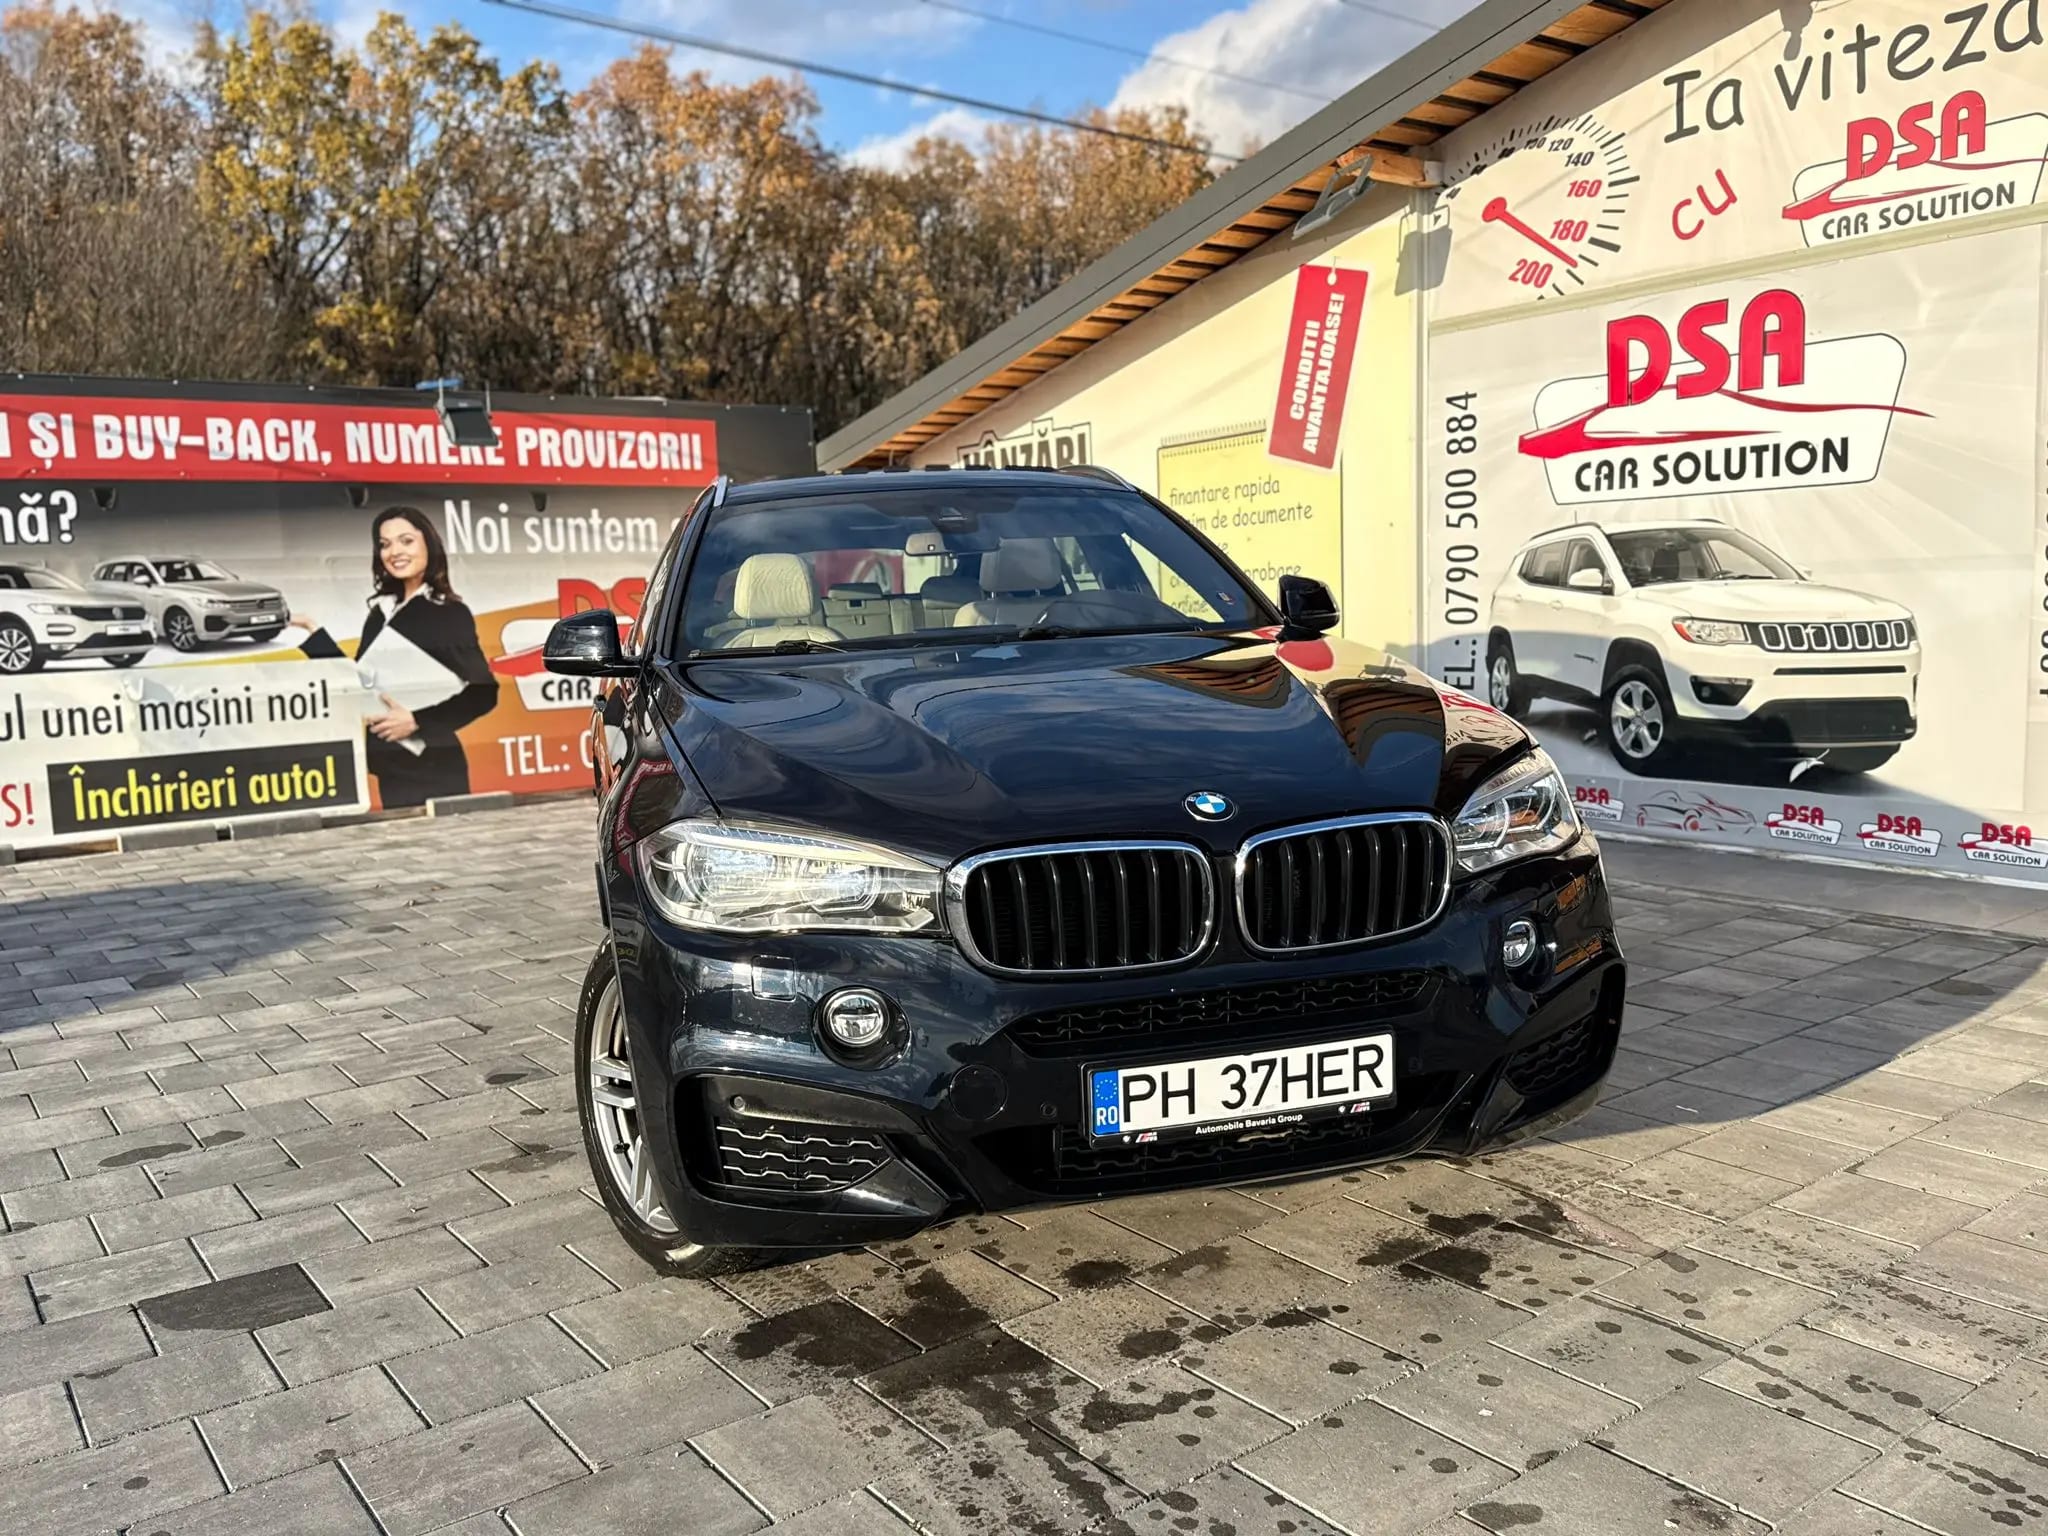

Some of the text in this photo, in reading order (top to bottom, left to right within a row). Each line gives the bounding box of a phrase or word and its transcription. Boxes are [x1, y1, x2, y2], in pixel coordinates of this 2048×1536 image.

[1774, 0, 2044, 111] viteza
[1548, 138, 1574, 152] 120
[1846, 90, 1986, 181] DSA
[1564, 151, 1595, 168] 140
[1567, 179, 1602, 198] 160
[1672, 169, 1737, 240] cu
[1822, 181, 2016, 240] CAR SOLUTION
[1550, 219, 1589, 242] 180
[1508, 258, 1553, 288] 200
[1606, 288, 1806, 408] DSA
[1290, 320, 1321, 420] CONDITII
[1446, 391, 1478, 455] 884
[93, 414, 332, 465] BUY-BACK,
[515, 427, 703, 471] PROVIZORII
[1575, 436, 1849, 493] CAR SOLUTION
[1234, 474, 1280, 502] rapida
[1445, 468, 1478, 529] 500
[444, 500, 658, 554] Noi suntem
[1211, 509, 1228, 529] de
[1232, 501, 1313, 528] documente
[1445, 544, 1479, 625] 0790
[1444, 640, 1477, 690] EL.:
[541, 677, 593, 702] CAR
[42, 693, 123, 738] unei
[139, 686, 254, 738] mașini
[268, 679, 330, 721] noi!
[497, 734, 571, 777] TEL.:
[68, 755, 338, 821] Închirieri auto!
[1576, 786, 1609, 805] DSA
[1783, 803, 1824, 826] DSA
[1877, 813, 1922, 837] DSA
[1775, 829, 1833, 843] CAR SOLUTION
[1870, 840, 1931, 855] CAR SOLUTION
[1981, 822, 2032, 847] DSA
[1972, 850, 2041, 866] CAR SOLUTION
[1122, 1067, 1196, 1123] PH
[1096, 1105, 1118, 1126] RO
[1195, 1112, 1303, 1135] Automobile Bavaria Group
